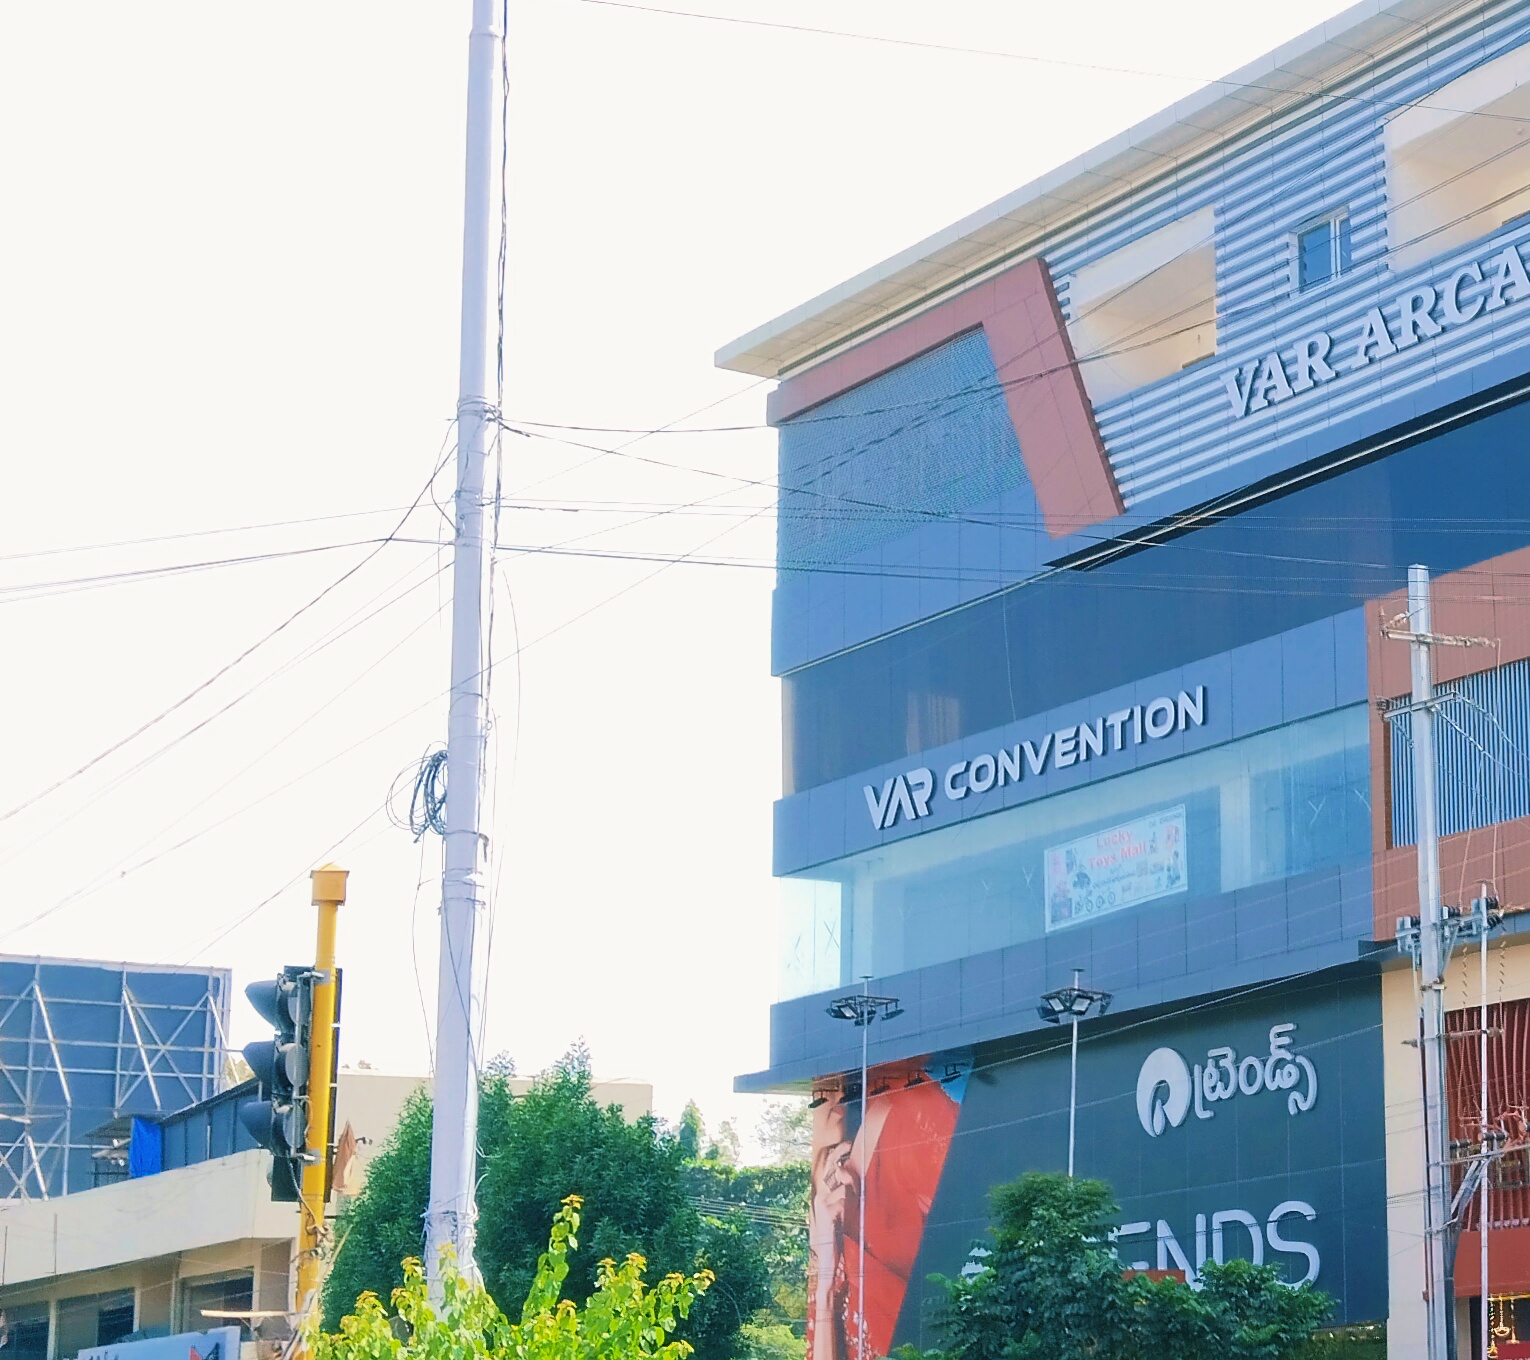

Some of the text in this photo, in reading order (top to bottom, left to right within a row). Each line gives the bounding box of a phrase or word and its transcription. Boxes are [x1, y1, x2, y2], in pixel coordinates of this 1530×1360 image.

[1220, 331, 1338, 418] VAR
[863, 685, 1204, 830] VAR CONVENTION
[1096, 830, 1132, 848] Lucky
